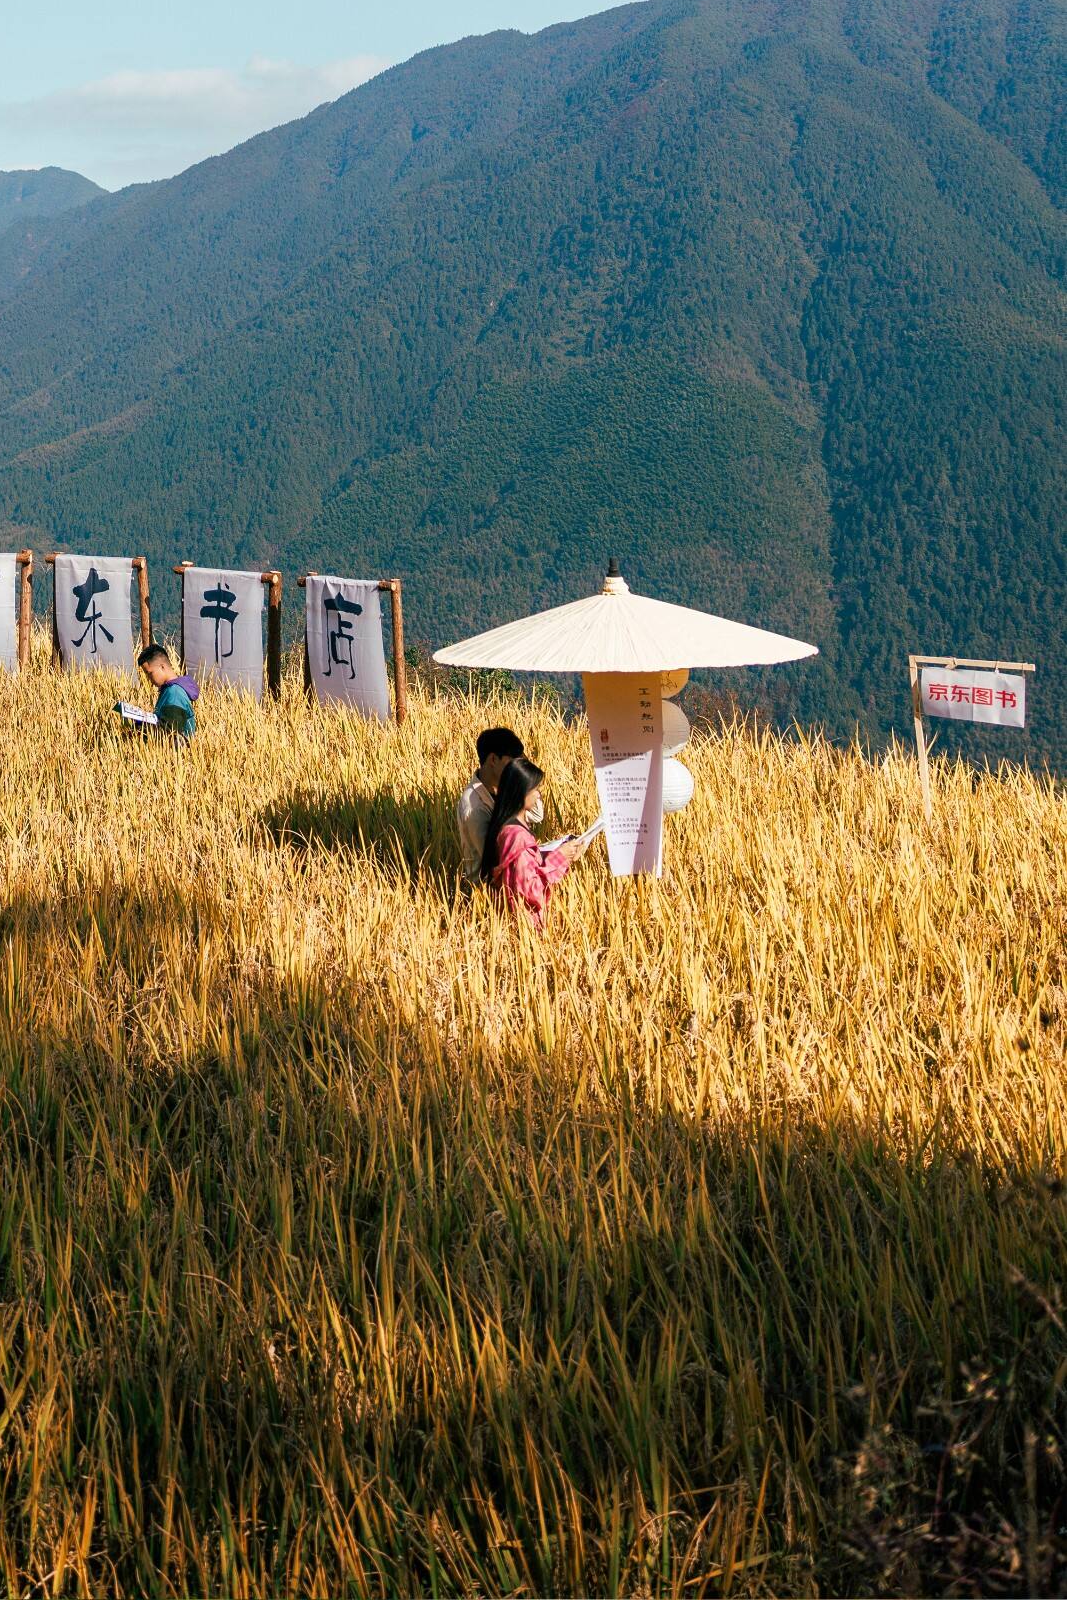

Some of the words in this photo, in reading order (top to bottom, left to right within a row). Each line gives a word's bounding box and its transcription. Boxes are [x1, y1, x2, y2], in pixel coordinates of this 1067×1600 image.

[71, 567, 115, 654] 东
[199, 581, 239, 664] 书
[322, 591, 364, 680] 店
[928, 683, 1017, 709] 京东图书
